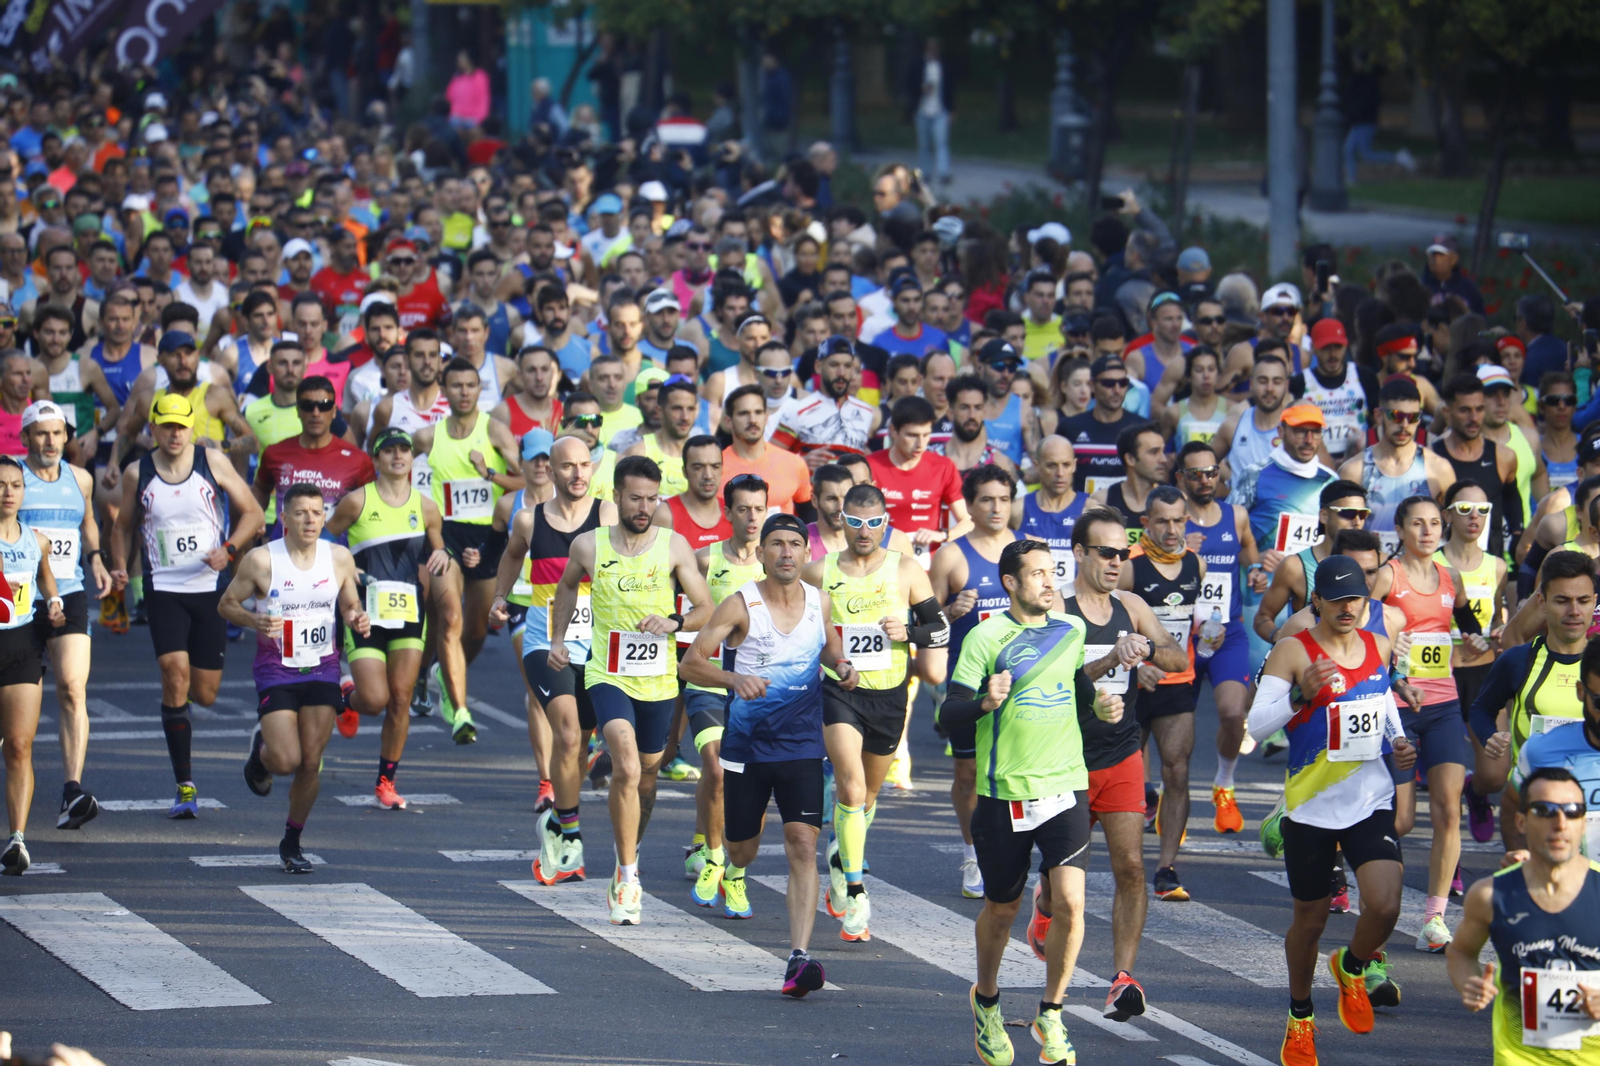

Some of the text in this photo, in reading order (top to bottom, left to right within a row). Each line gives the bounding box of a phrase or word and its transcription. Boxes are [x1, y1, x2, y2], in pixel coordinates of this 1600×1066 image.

[292, 469, 321, 479] MEDIA
[452, 488, 489, 505] 1179
[27, 511, 56, 522] MEDIA
[1294, 525, 1319, 543] 419
[49, 539, 72, 556] 32
[176, 535, 198, 552] 65
[388, 593, 406, 609] 55
[299, 625, 325, 645] 160
[848, 635, 882, 653] 228
[625, 643, 658, 661] 229
[1420, 646, 1441, 664] 66
[1348, 711, 1379, 734] 381
[1546, 988, 1580, 1014] 42
